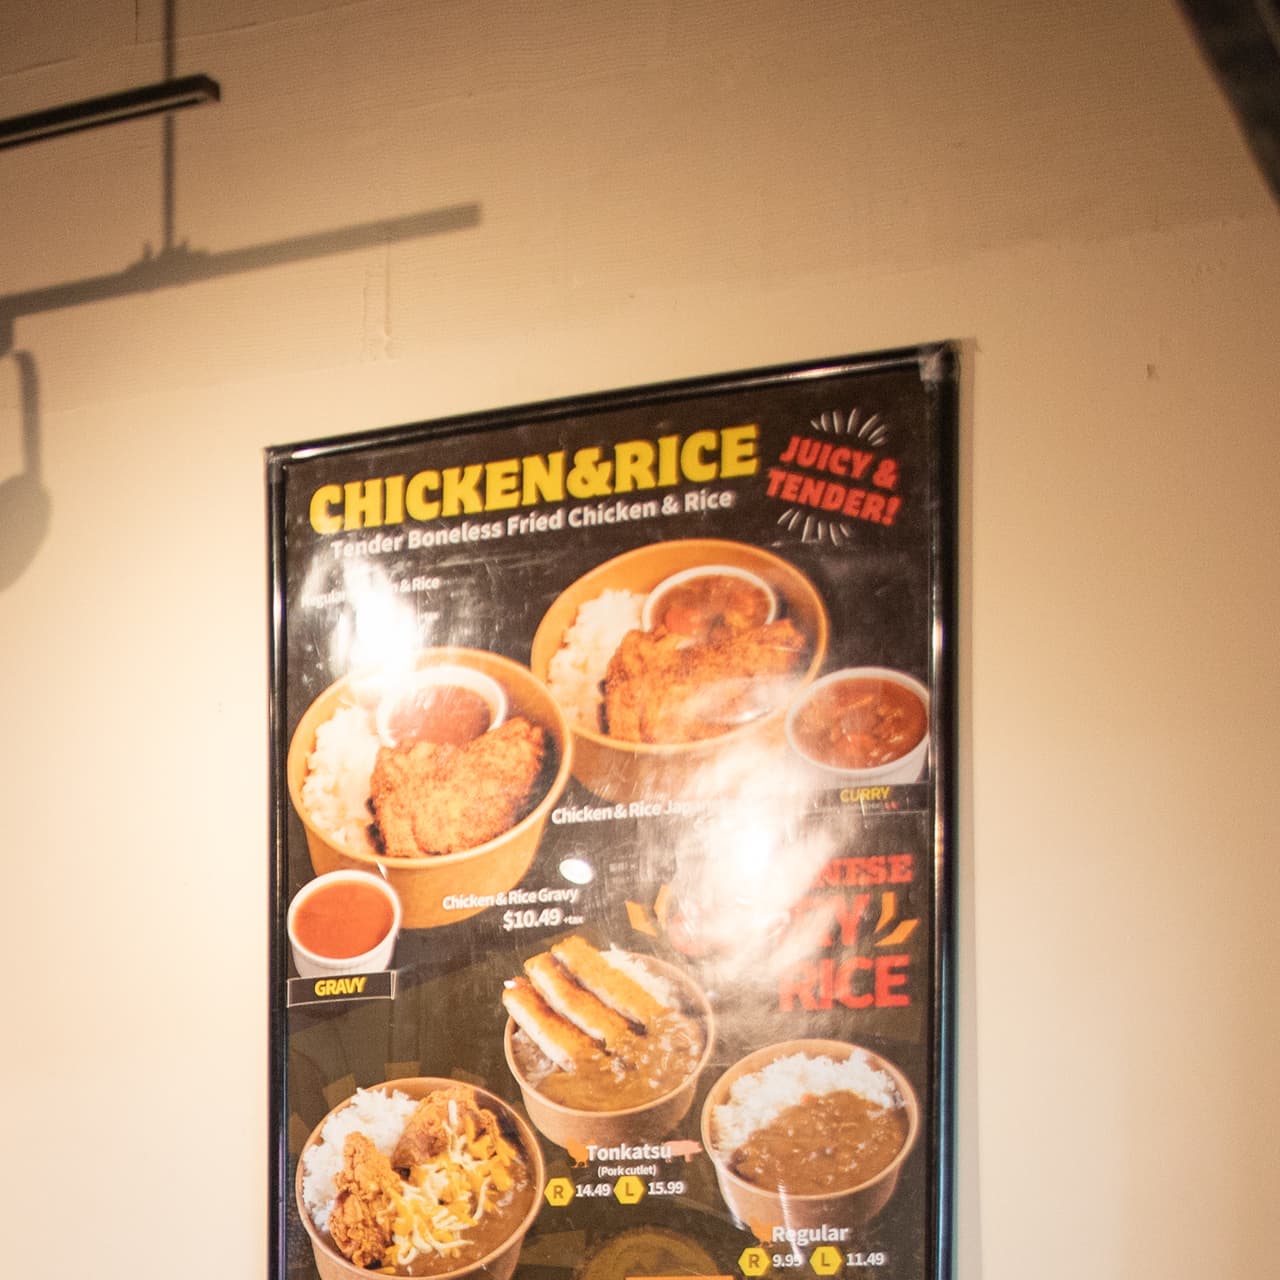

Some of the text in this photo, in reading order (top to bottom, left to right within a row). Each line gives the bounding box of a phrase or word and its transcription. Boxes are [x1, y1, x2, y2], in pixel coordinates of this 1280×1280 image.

[780, 435, 899, 489] JUICY &
[767, 468, 903, 527] TENDER!
[330, 489, 733, 559] Tender Boneless Fried Chicken & Rice
[412, 576, 440, 591] Rice
[840, 785, 891, 802] CURRY
[552, 805, 611, 825] Chicken
[613, 804, 627, 819] &
[629, 802, 662, 817] Rice
[442, 887, 579, 910] Chicken & Rice Gravy
[503, 908, 562, 931] $10.49
[314, 976, 367, 997] GRAVY
[778, 953, 911, 1012] RICE
[586, 1143, 672, 1161] Tonkatsu
[597, 1164, 657, 1178] (Pork cutlet)
[553, 1181, 684, 1199] R 14.49 L 15.99
[772, 1224, 848, 1246] Regular
[749, 1254, 760, 1268] R
[821, 1252, 831, 1267] L
[846, 1252, 885, 1266] 11.49
